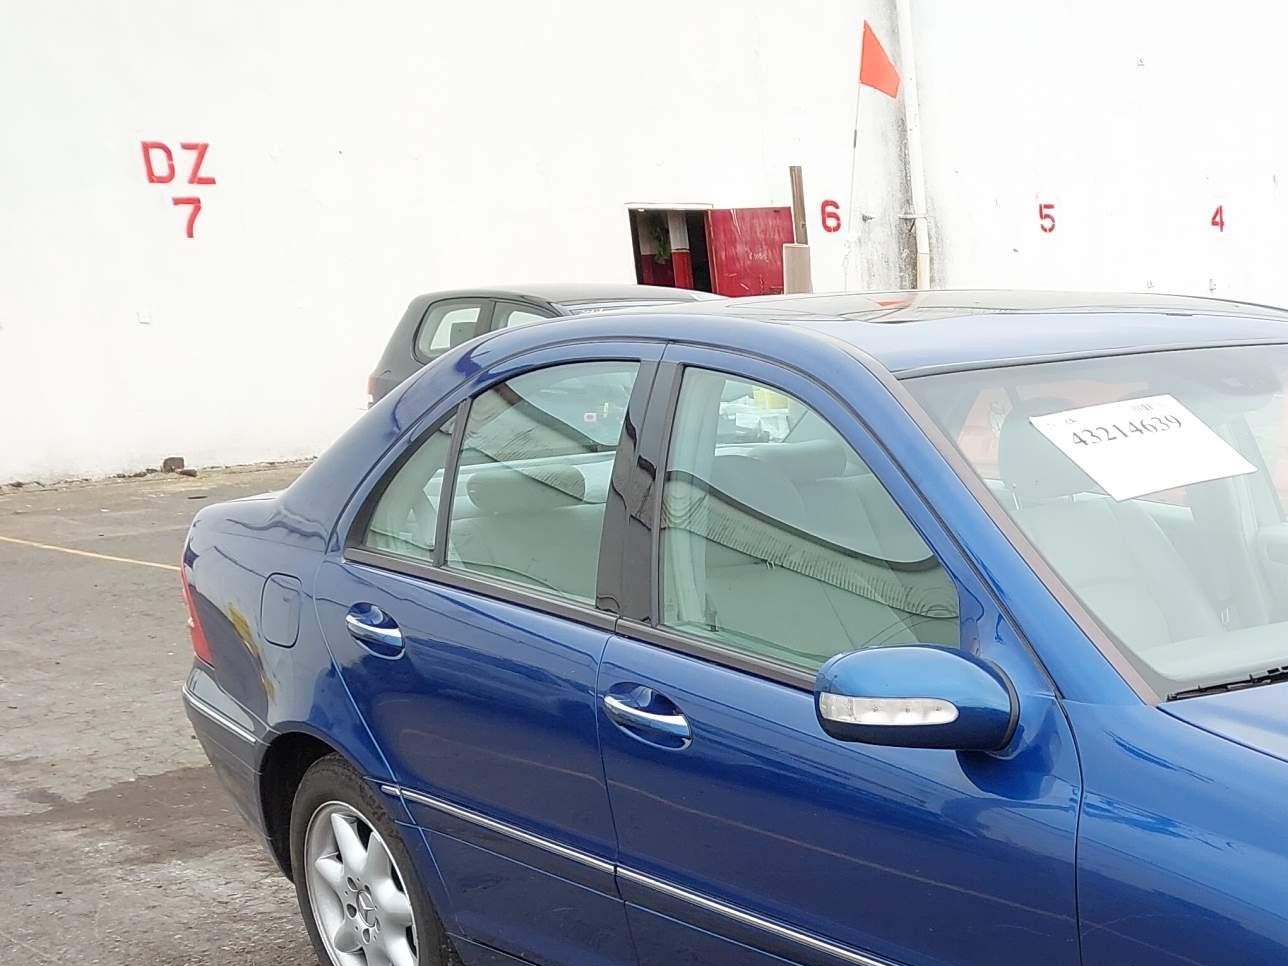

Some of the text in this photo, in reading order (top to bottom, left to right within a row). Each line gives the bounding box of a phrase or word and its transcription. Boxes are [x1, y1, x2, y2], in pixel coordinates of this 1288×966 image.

[140, 140, 217, 187] DZ
[171, 195, 203, 240] 7
[819, 198, 843, 234] 6
[1038, 202, 1056, 234] 5
[1210, 205, 1226, 233] 4
[1071, 415, 1182, 446] 43214639
